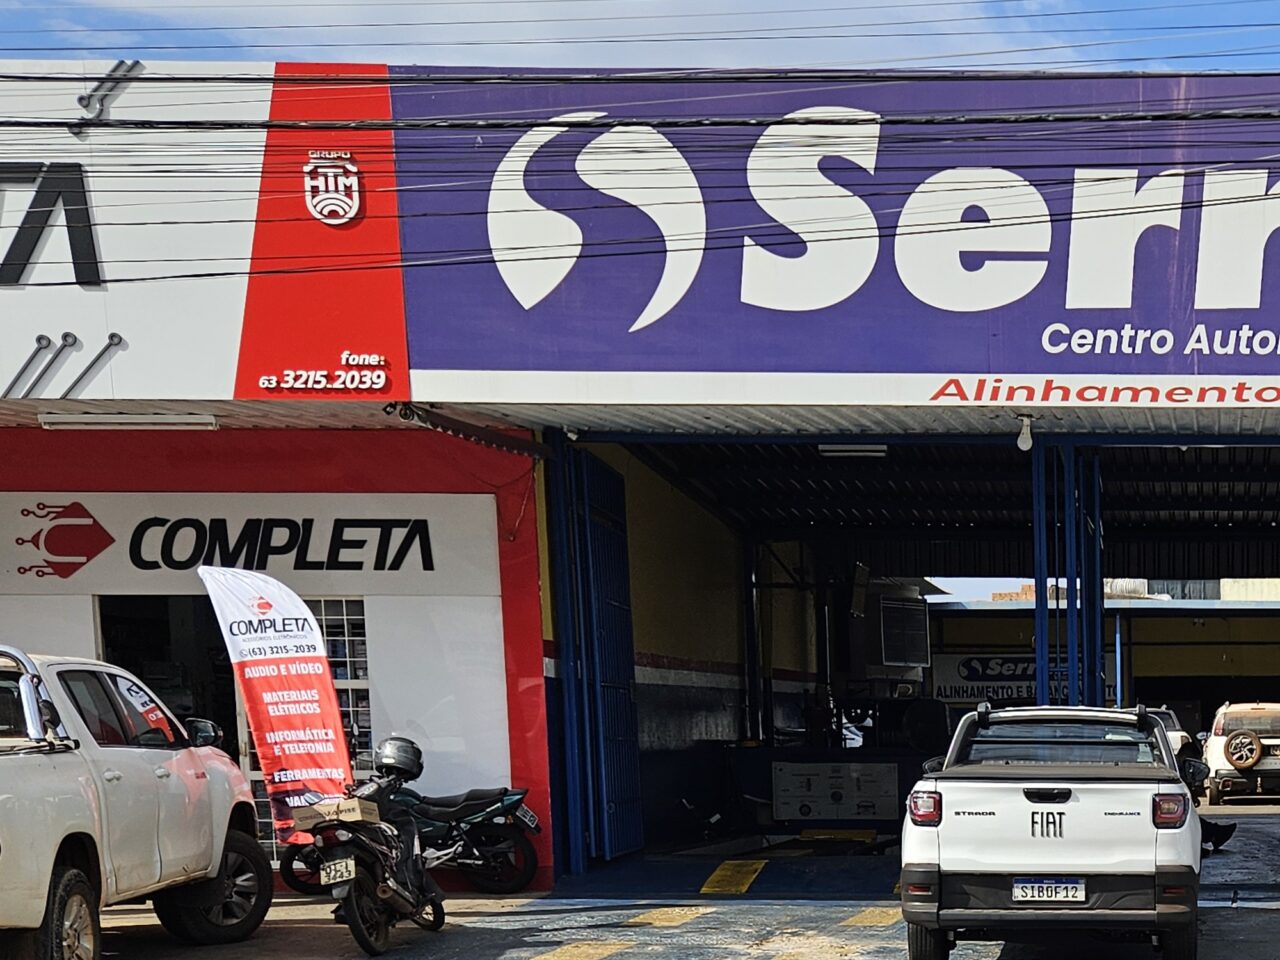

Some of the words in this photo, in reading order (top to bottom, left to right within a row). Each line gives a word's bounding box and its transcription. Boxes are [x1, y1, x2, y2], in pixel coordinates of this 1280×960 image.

[1041, 323, 1174, 354] Centro
[340, 350, 385, 365] fone:
[258, 375, 278, 388] 63
[280, 369, 386, 389] 3215.2039
[129, 517, 434, 571] COMPLETA
[229, 617, 314, 637] COMPLETA
[248, 647, 266, 657] (63)
[269, 644, 317, 654] 3215-2039
[280, 664, 287, 676] E
[288, 661, 323, 675] VÍDEO
[262, 688, 319, 703] MATERIAIS
[936, 684, 1014, 699] ALINHAMENTO
[1016, 685, 1023, 698] E
[267, 702, 321, 716] ELÉTRICOS
[265, 727, 336, 743] INFORMÁTICA
[274, 745, 282, 756] E
[273, 768, 345, 783] FERRAMENTAS
[1031, 811, 1066, 838] FIAT
